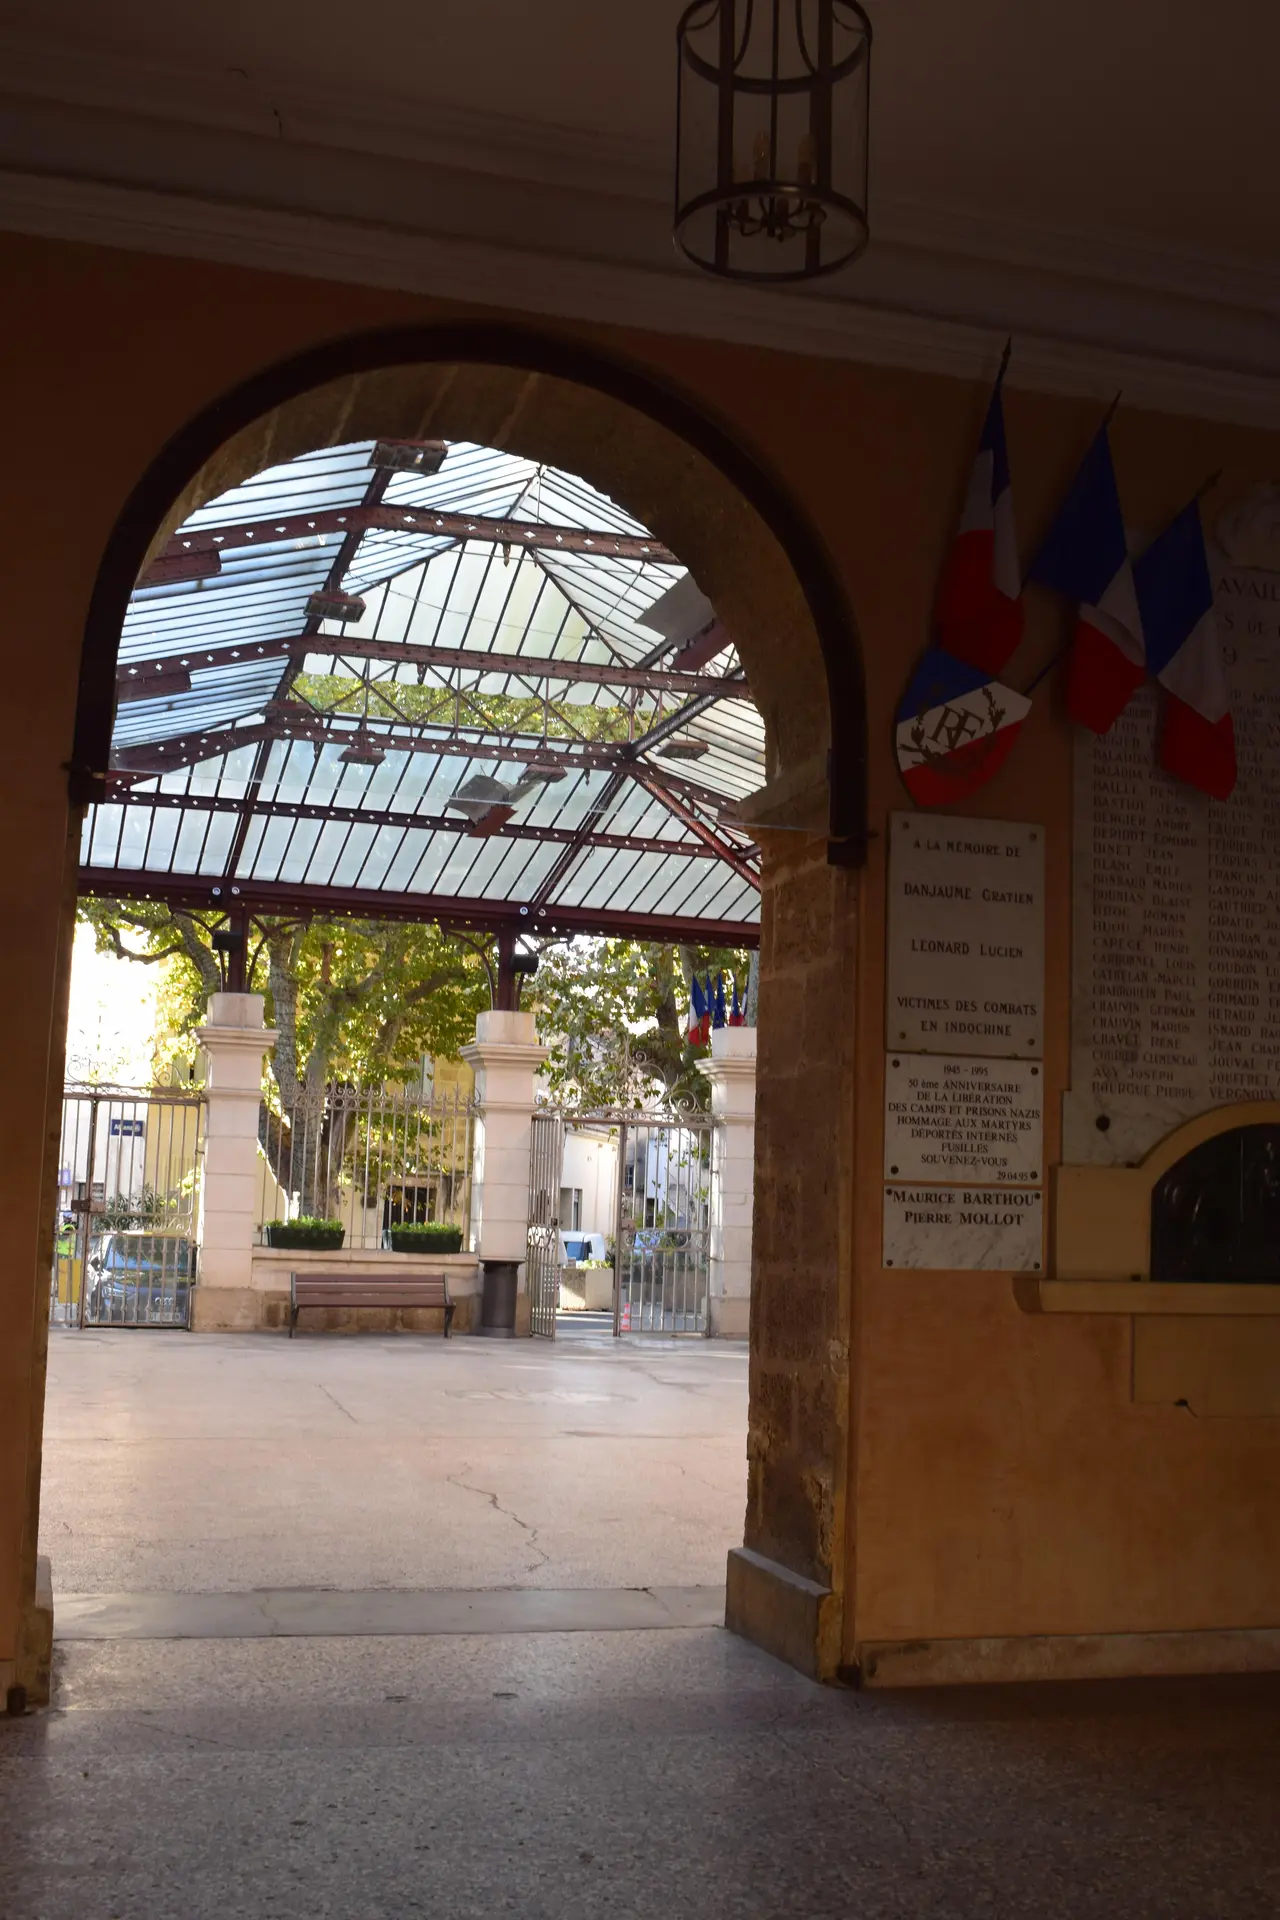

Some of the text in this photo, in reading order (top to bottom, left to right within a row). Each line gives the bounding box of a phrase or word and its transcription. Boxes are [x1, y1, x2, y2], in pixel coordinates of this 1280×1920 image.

[926, 839, 941, 852] LA
[1005, 845, 1021, 857] DE
[904, 882, 1034, 905] DANJAUME GRATIEN
[980, 943, 1024, 959] LUCIEN
[897, 996, 1038, 1016] VICTIMES DES COMBATS
[920, 1020, 1012, 1037] EN INDOCHINE
[1208, 1038, 1242, 1053] JEAN
[942, 1080, 1021, 1093] ANNIVERSAIRE
[917, 1091, 931, 1101] DE
[934, 1092, 948, 1103] LA
[888, 1102, 1041, 1119] DES CAMPS ET PRISONS NAZIS
[897, 1114, 1032, 1131] HOMMAGE AUX MARTYRS
[921, 1153, 1008, 1168] SOUVENEZ-VOUS
[892, 1190, 1035, 1207] MAURICE BARTHOU
[904, 1210, 1024, 1226] PIERRE MOLLOT
